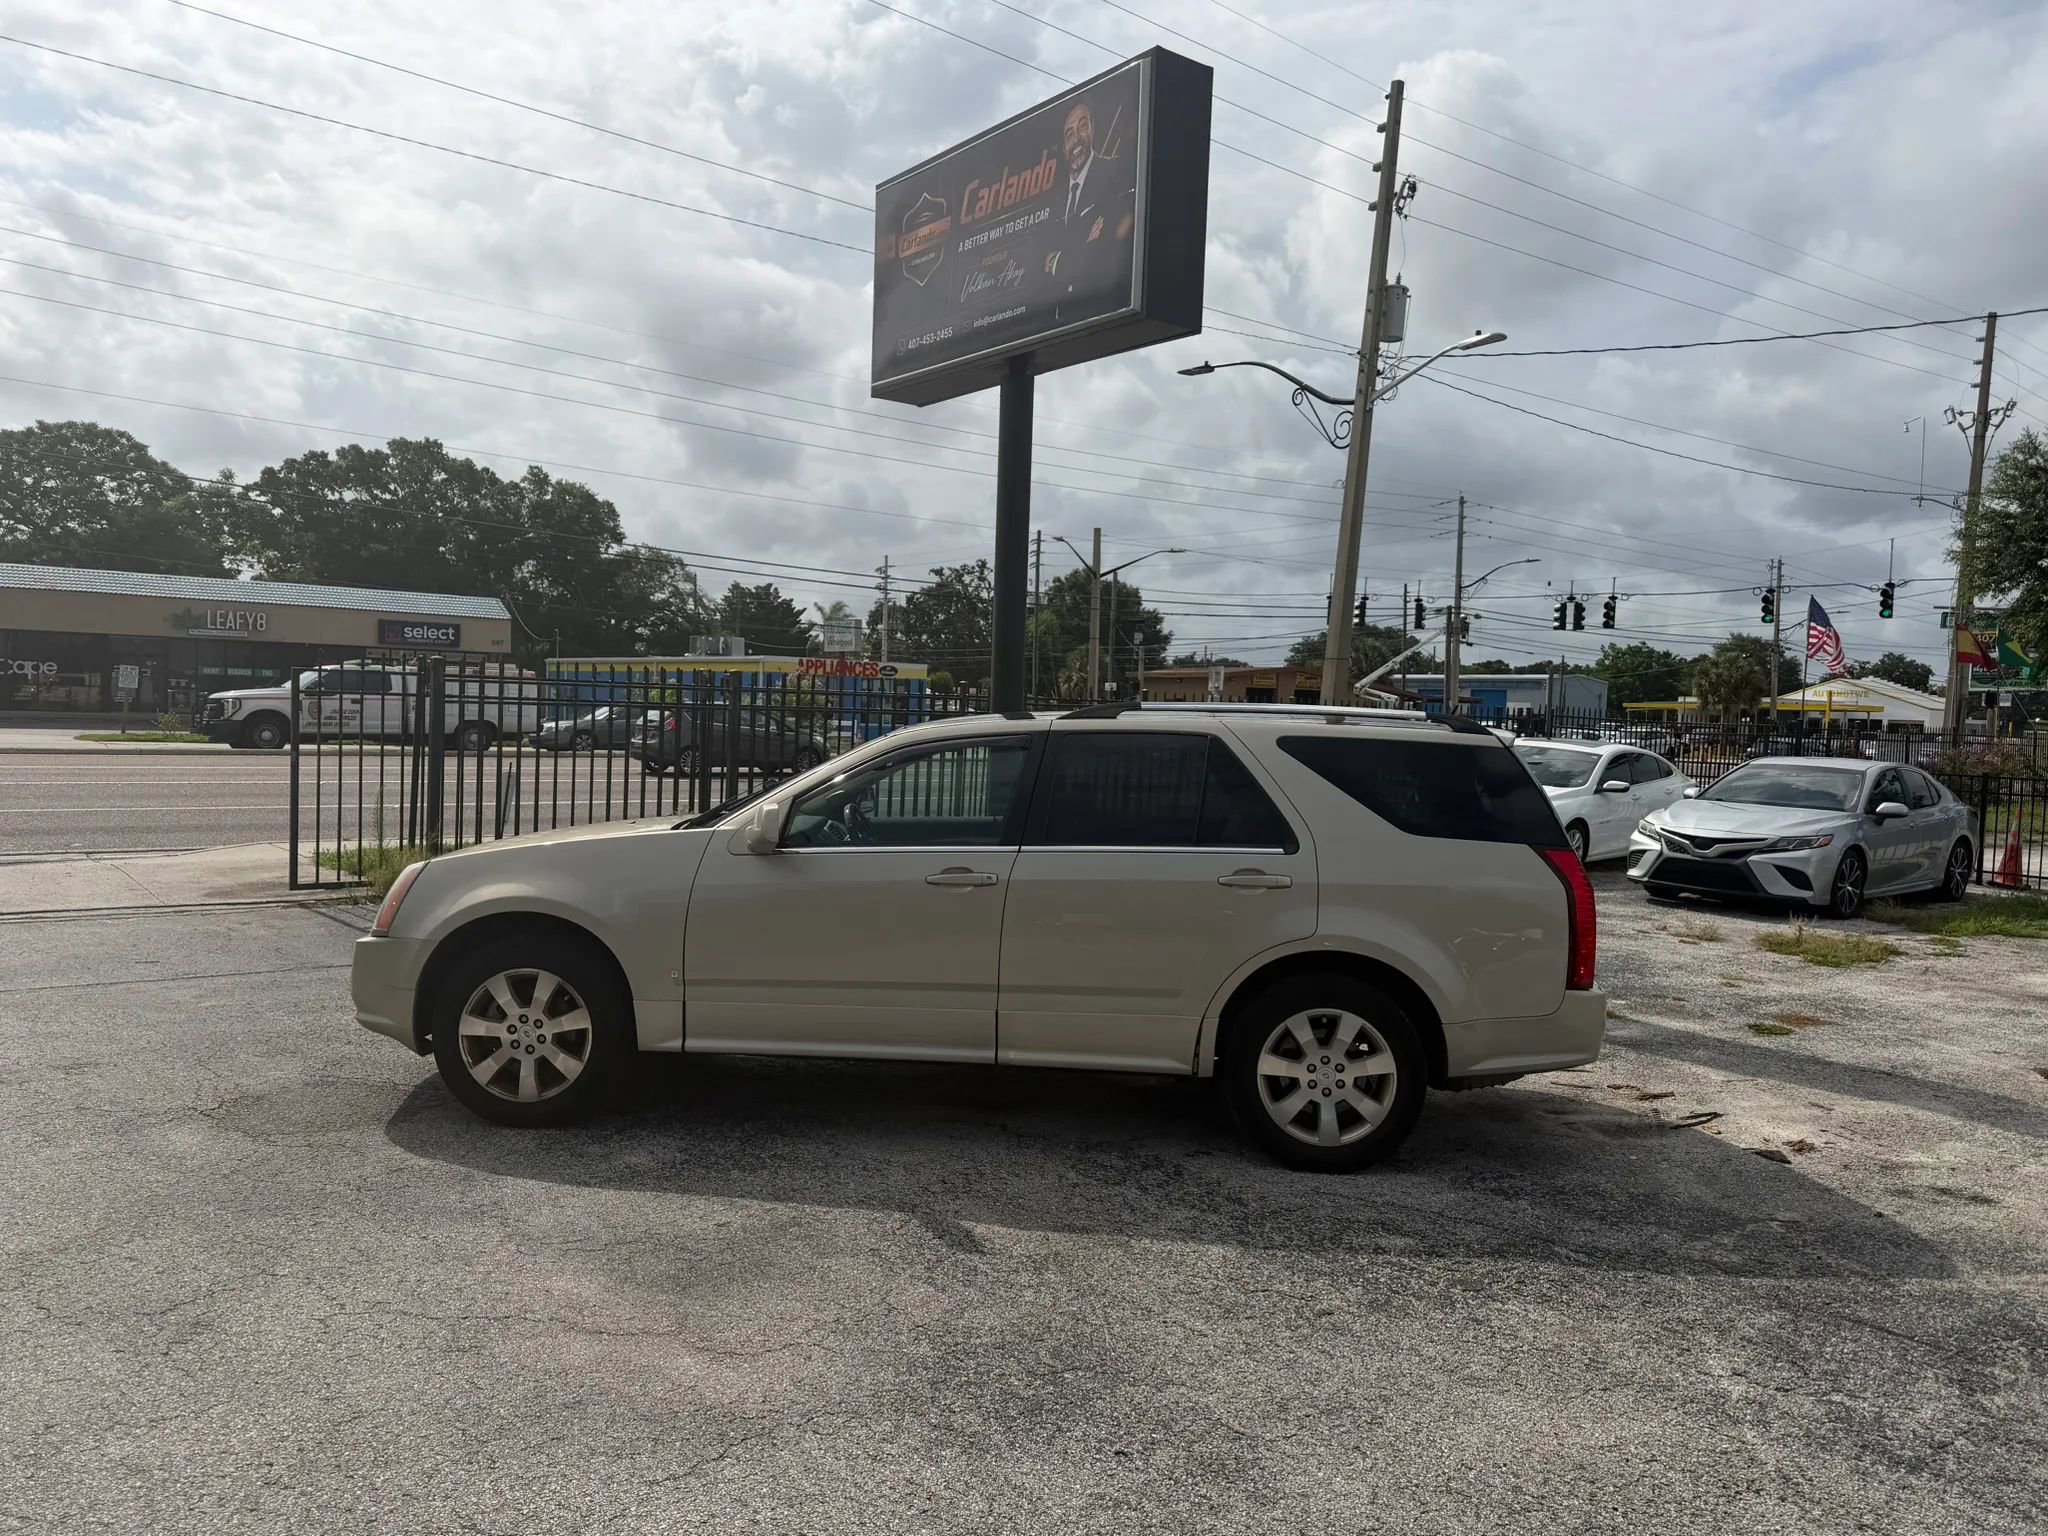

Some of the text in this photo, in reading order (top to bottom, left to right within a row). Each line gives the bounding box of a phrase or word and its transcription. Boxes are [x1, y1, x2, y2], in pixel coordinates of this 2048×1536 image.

[960, 149, 1057, 225] Carlando
[964, 232, 989, 252] BETTER
[989, 227, 1004, 241] WAY
[1005, 222, 1014, 234] TO
[1015, 216, 1028, 231] GET
[1034, 207, 1050, 223] CAR
[907, 327, 953, 350] 407-453-2455
[207, 609, 267, 631] LEAFY8
[403, 625, 455, 640] select
[798, 658, 881, 677] APPLIANCES
